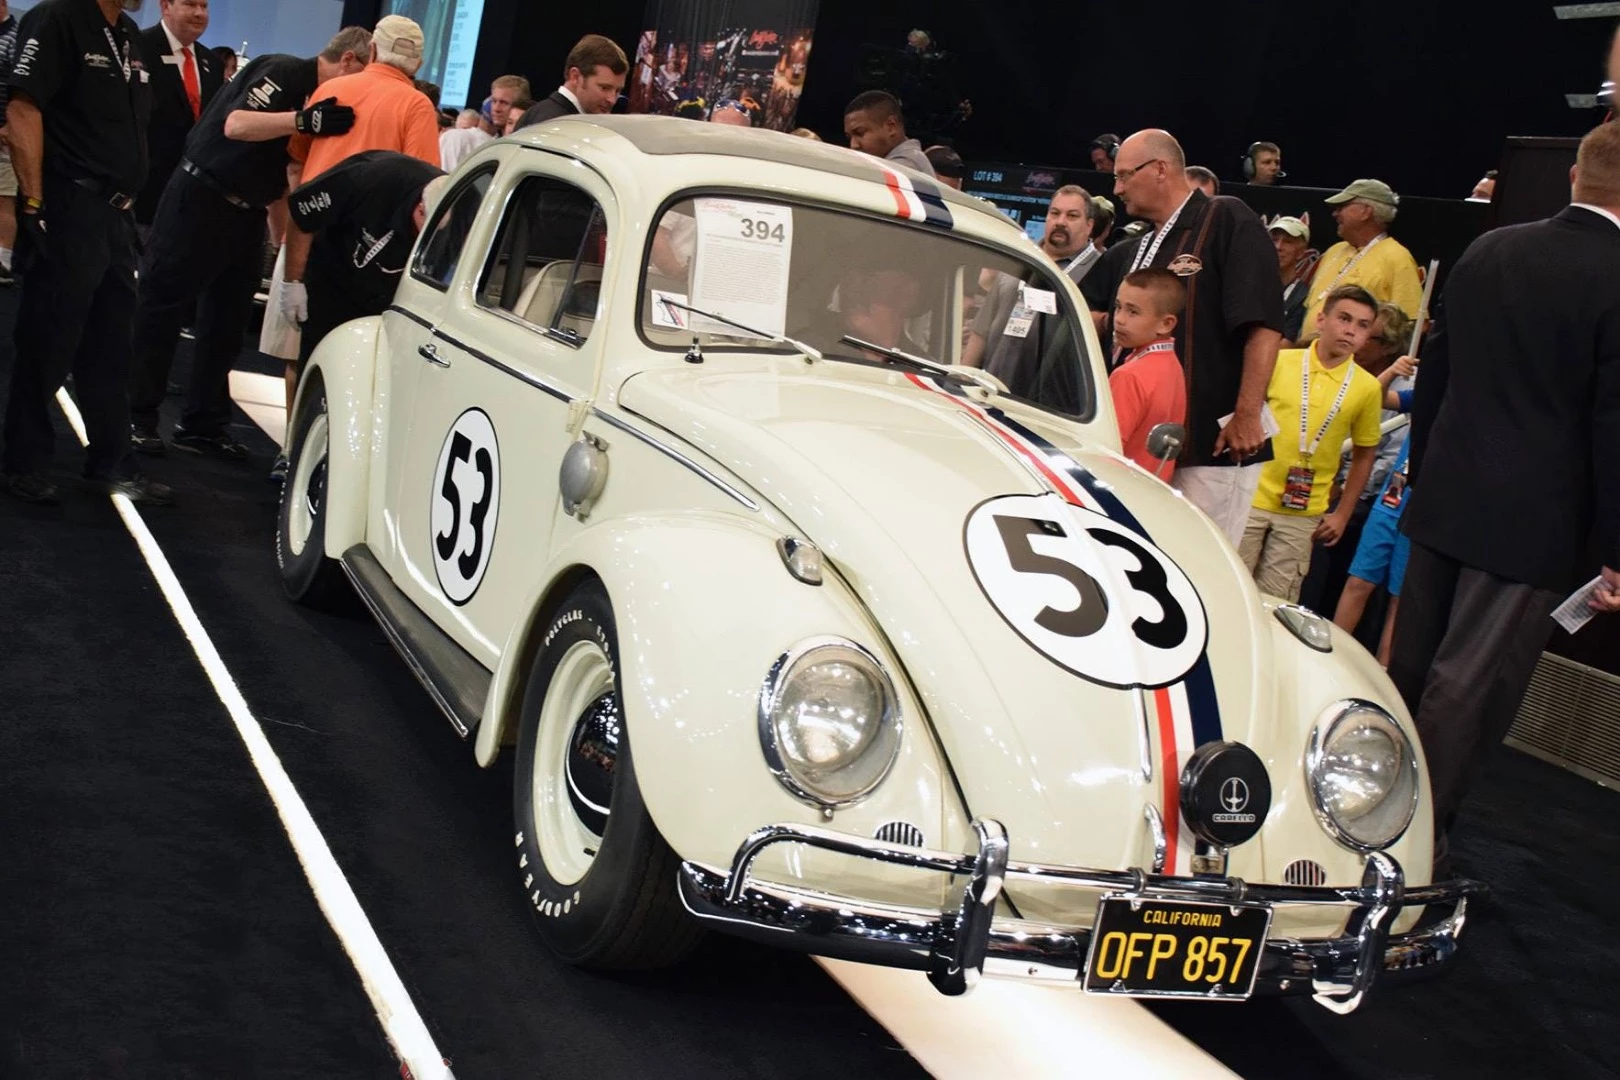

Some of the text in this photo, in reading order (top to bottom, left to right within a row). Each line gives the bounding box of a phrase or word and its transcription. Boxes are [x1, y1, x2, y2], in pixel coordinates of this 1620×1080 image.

[741, 218, 785, 243] 394
[436, 430, 493, 580] 53
[992, 514, 1188, 649] 53
[545, 609, 583, 646] POLYGLAS
[1212, 813, 1256, 823] CARELLO
[1143, 910, 1222, 928] CALIFORNIA
[1096, 931, 1252, 984] OFP 857
